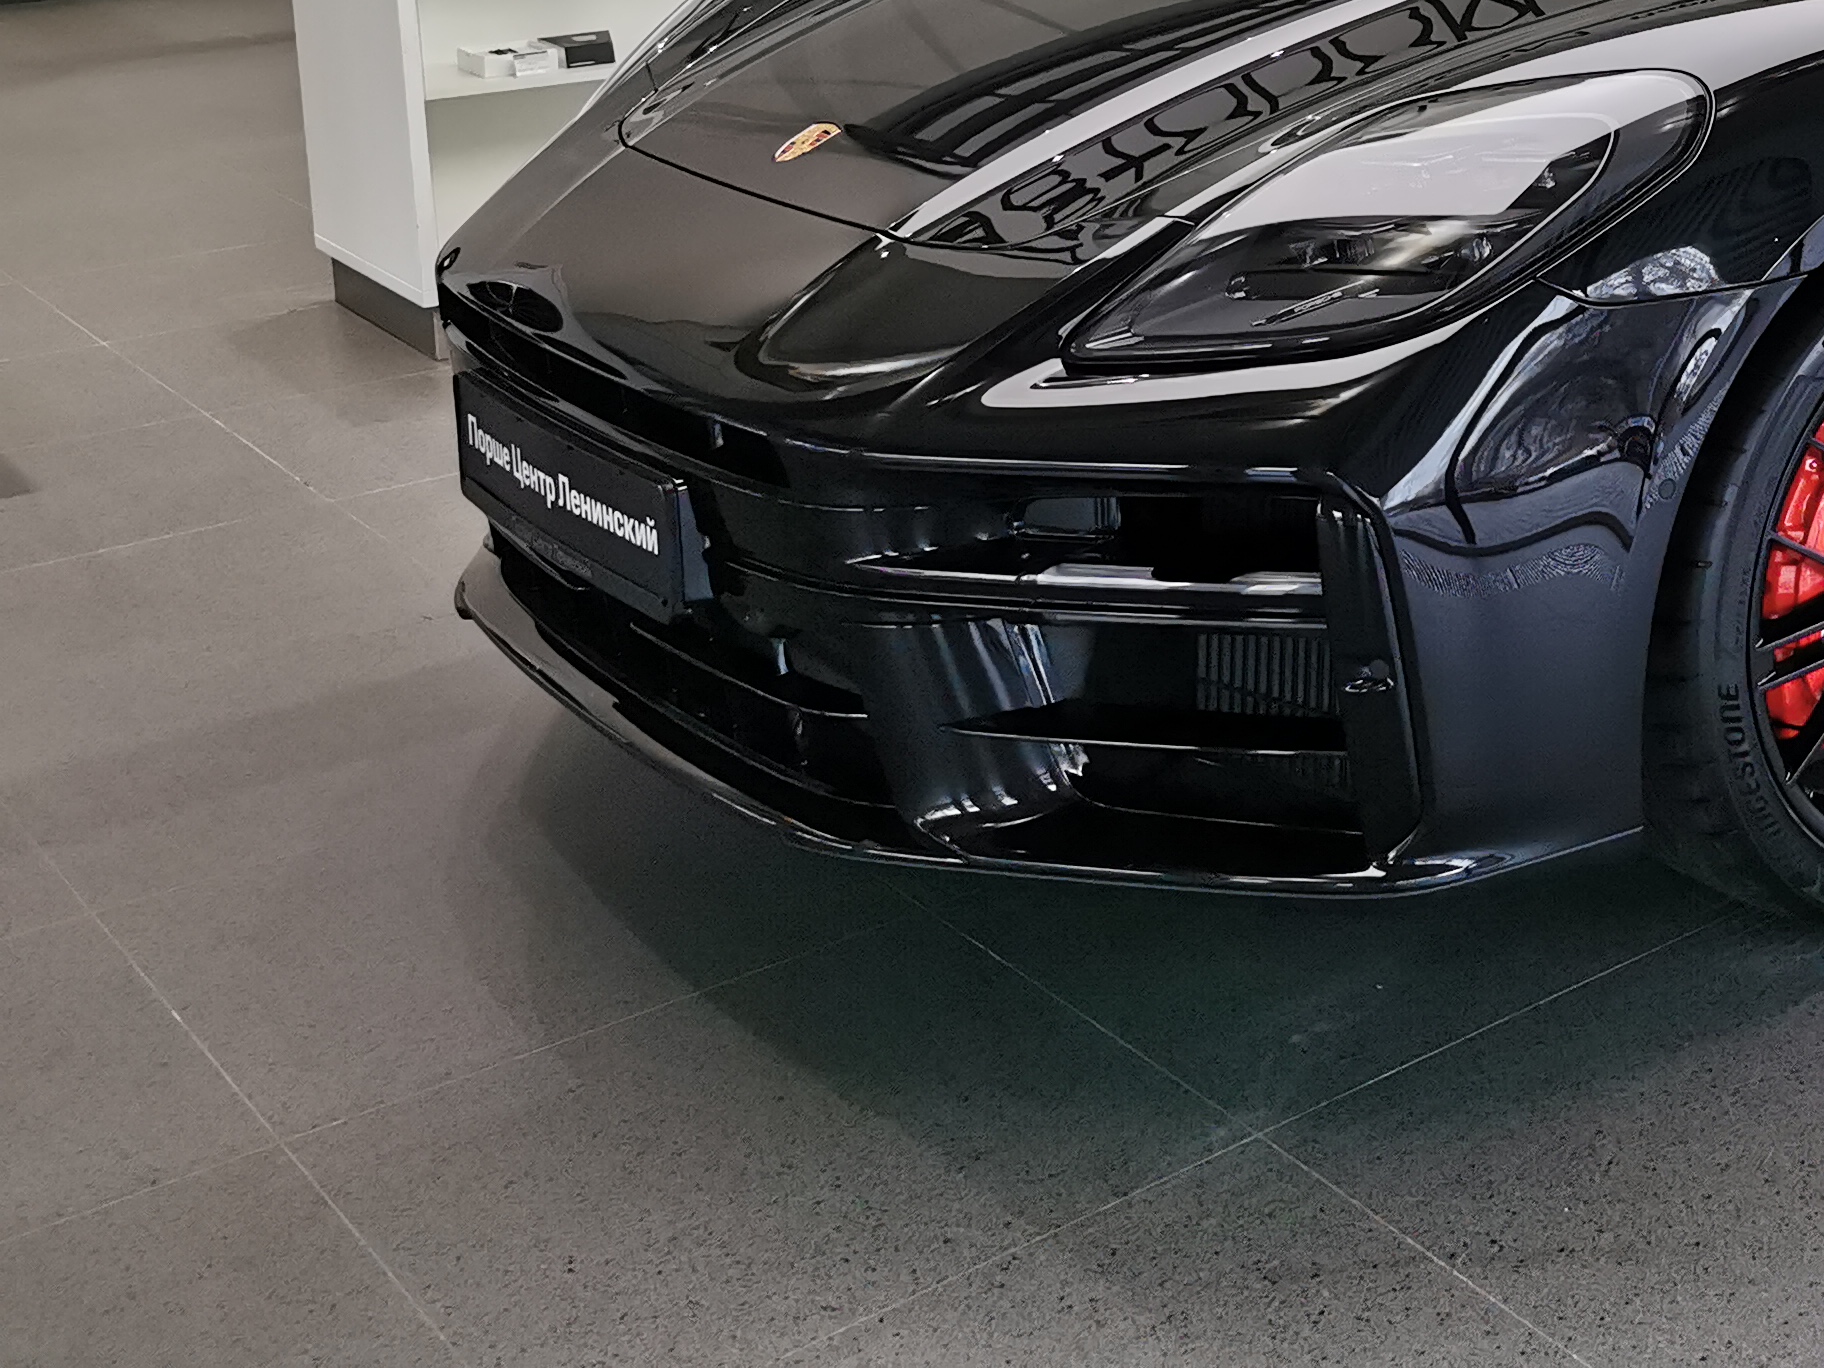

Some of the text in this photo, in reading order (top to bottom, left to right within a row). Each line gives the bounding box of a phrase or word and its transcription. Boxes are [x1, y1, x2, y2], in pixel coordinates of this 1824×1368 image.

[466, 413, 660, 556] Порше Центр Ленинский
